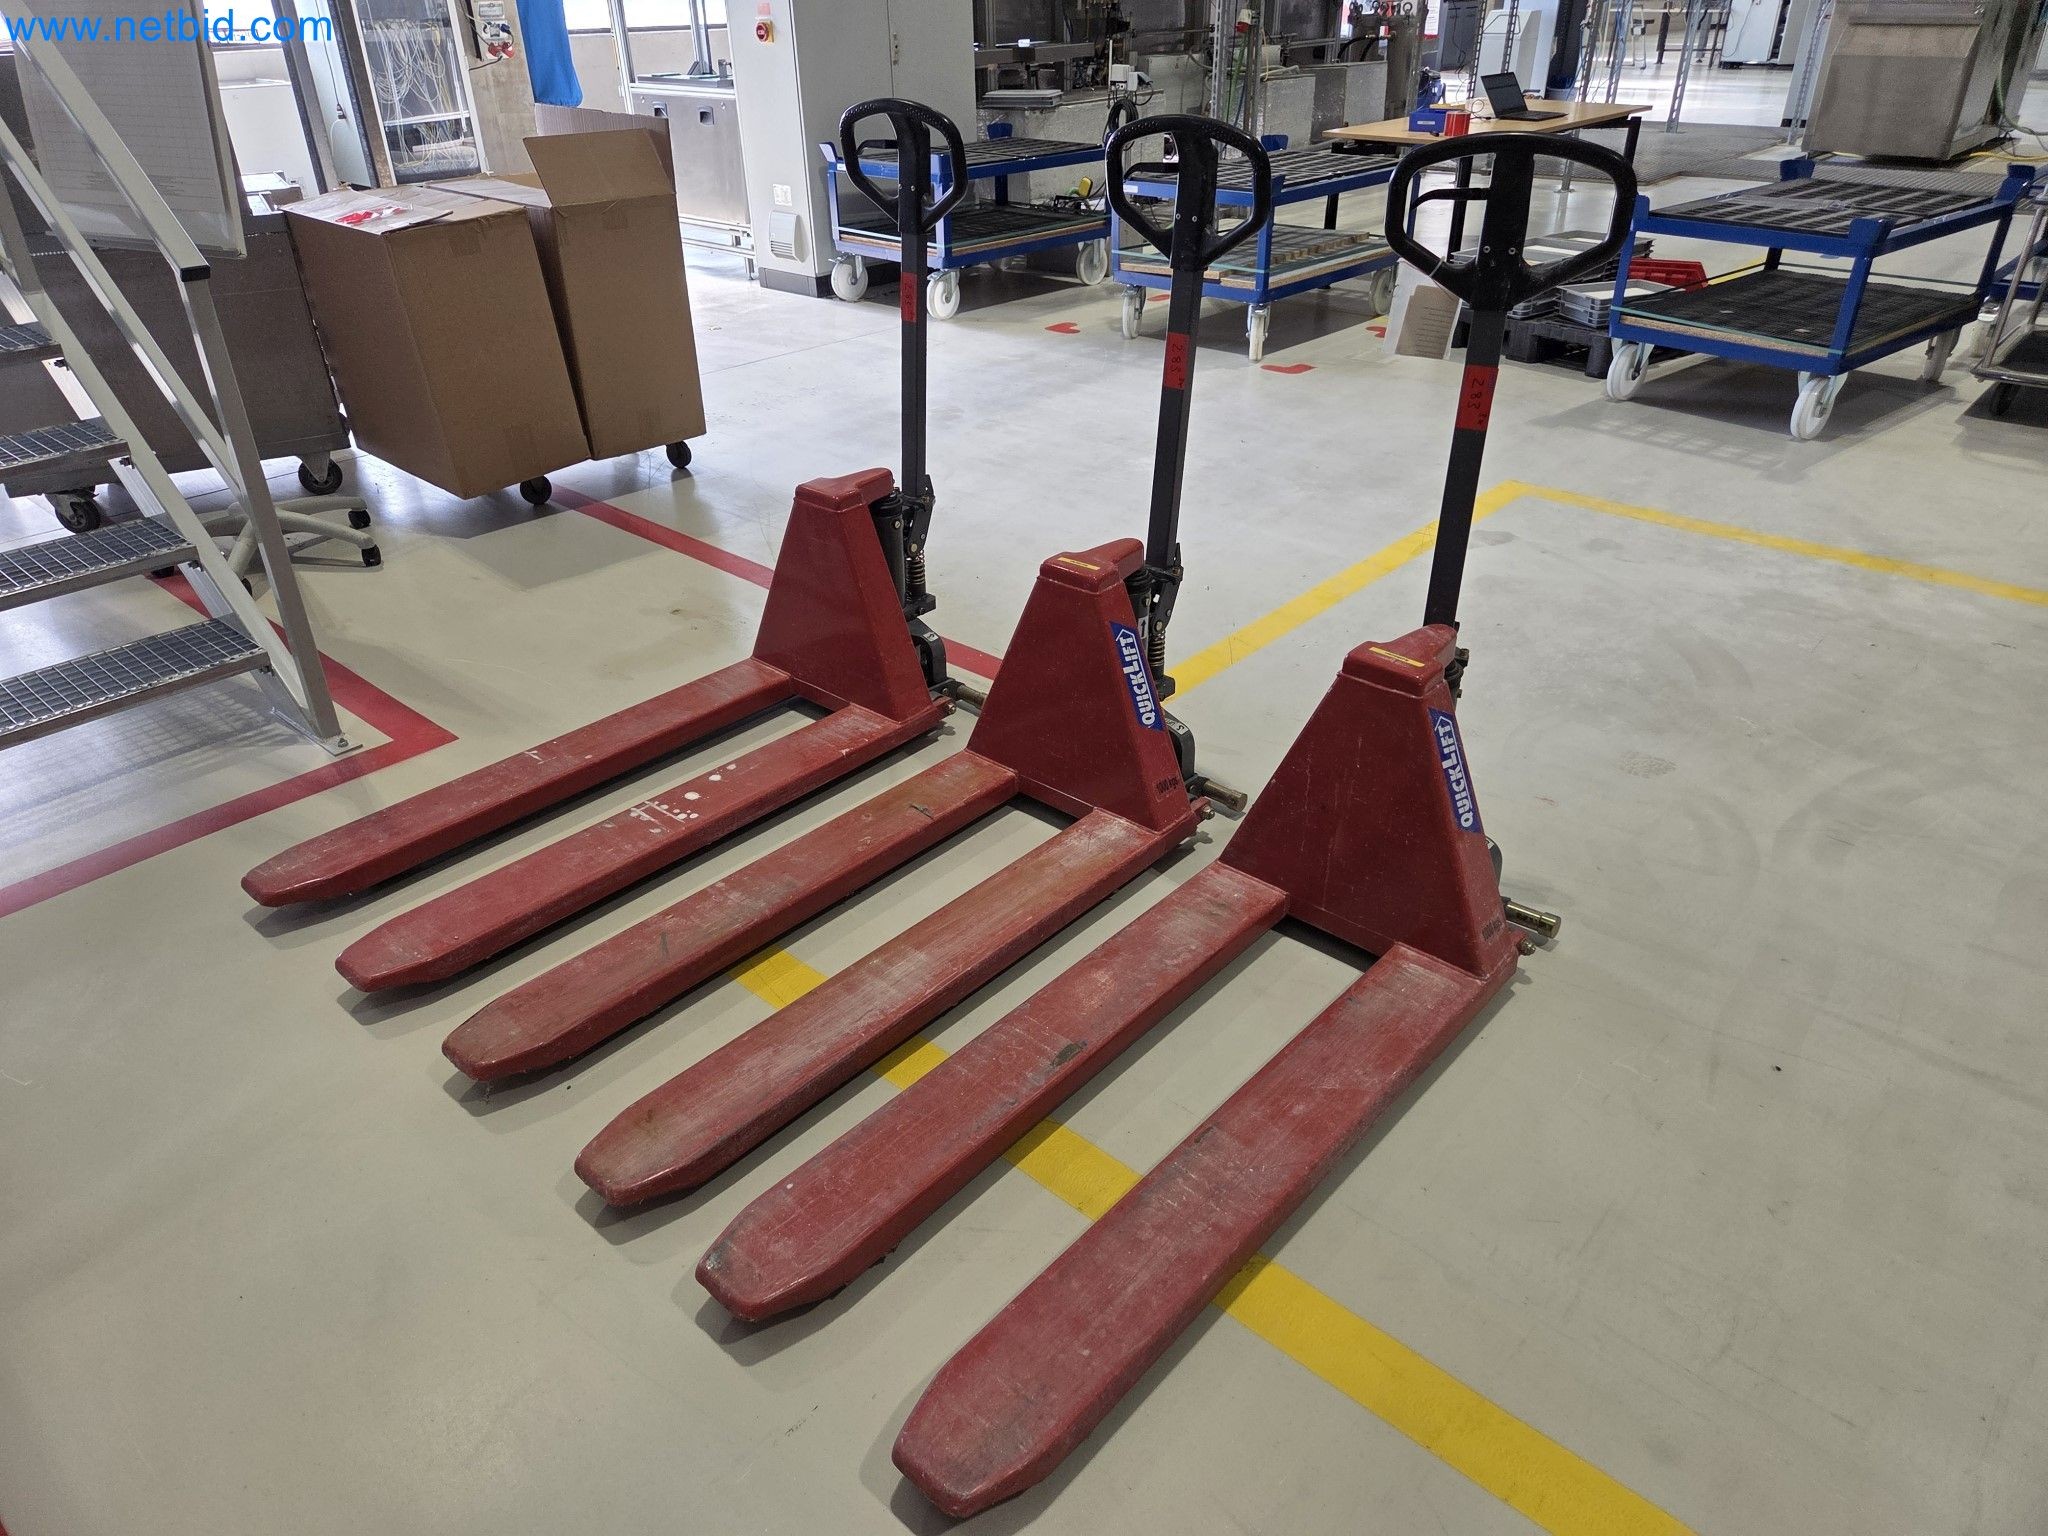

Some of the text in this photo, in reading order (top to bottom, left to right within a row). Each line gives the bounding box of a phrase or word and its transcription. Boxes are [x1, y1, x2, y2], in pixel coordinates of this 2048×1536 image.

[1467, 377, 1485, 410] 283
[1120, 636, 1156, 725] QUICKLIFT
[1438, 725, 1474, 828] QUICKLIFT
